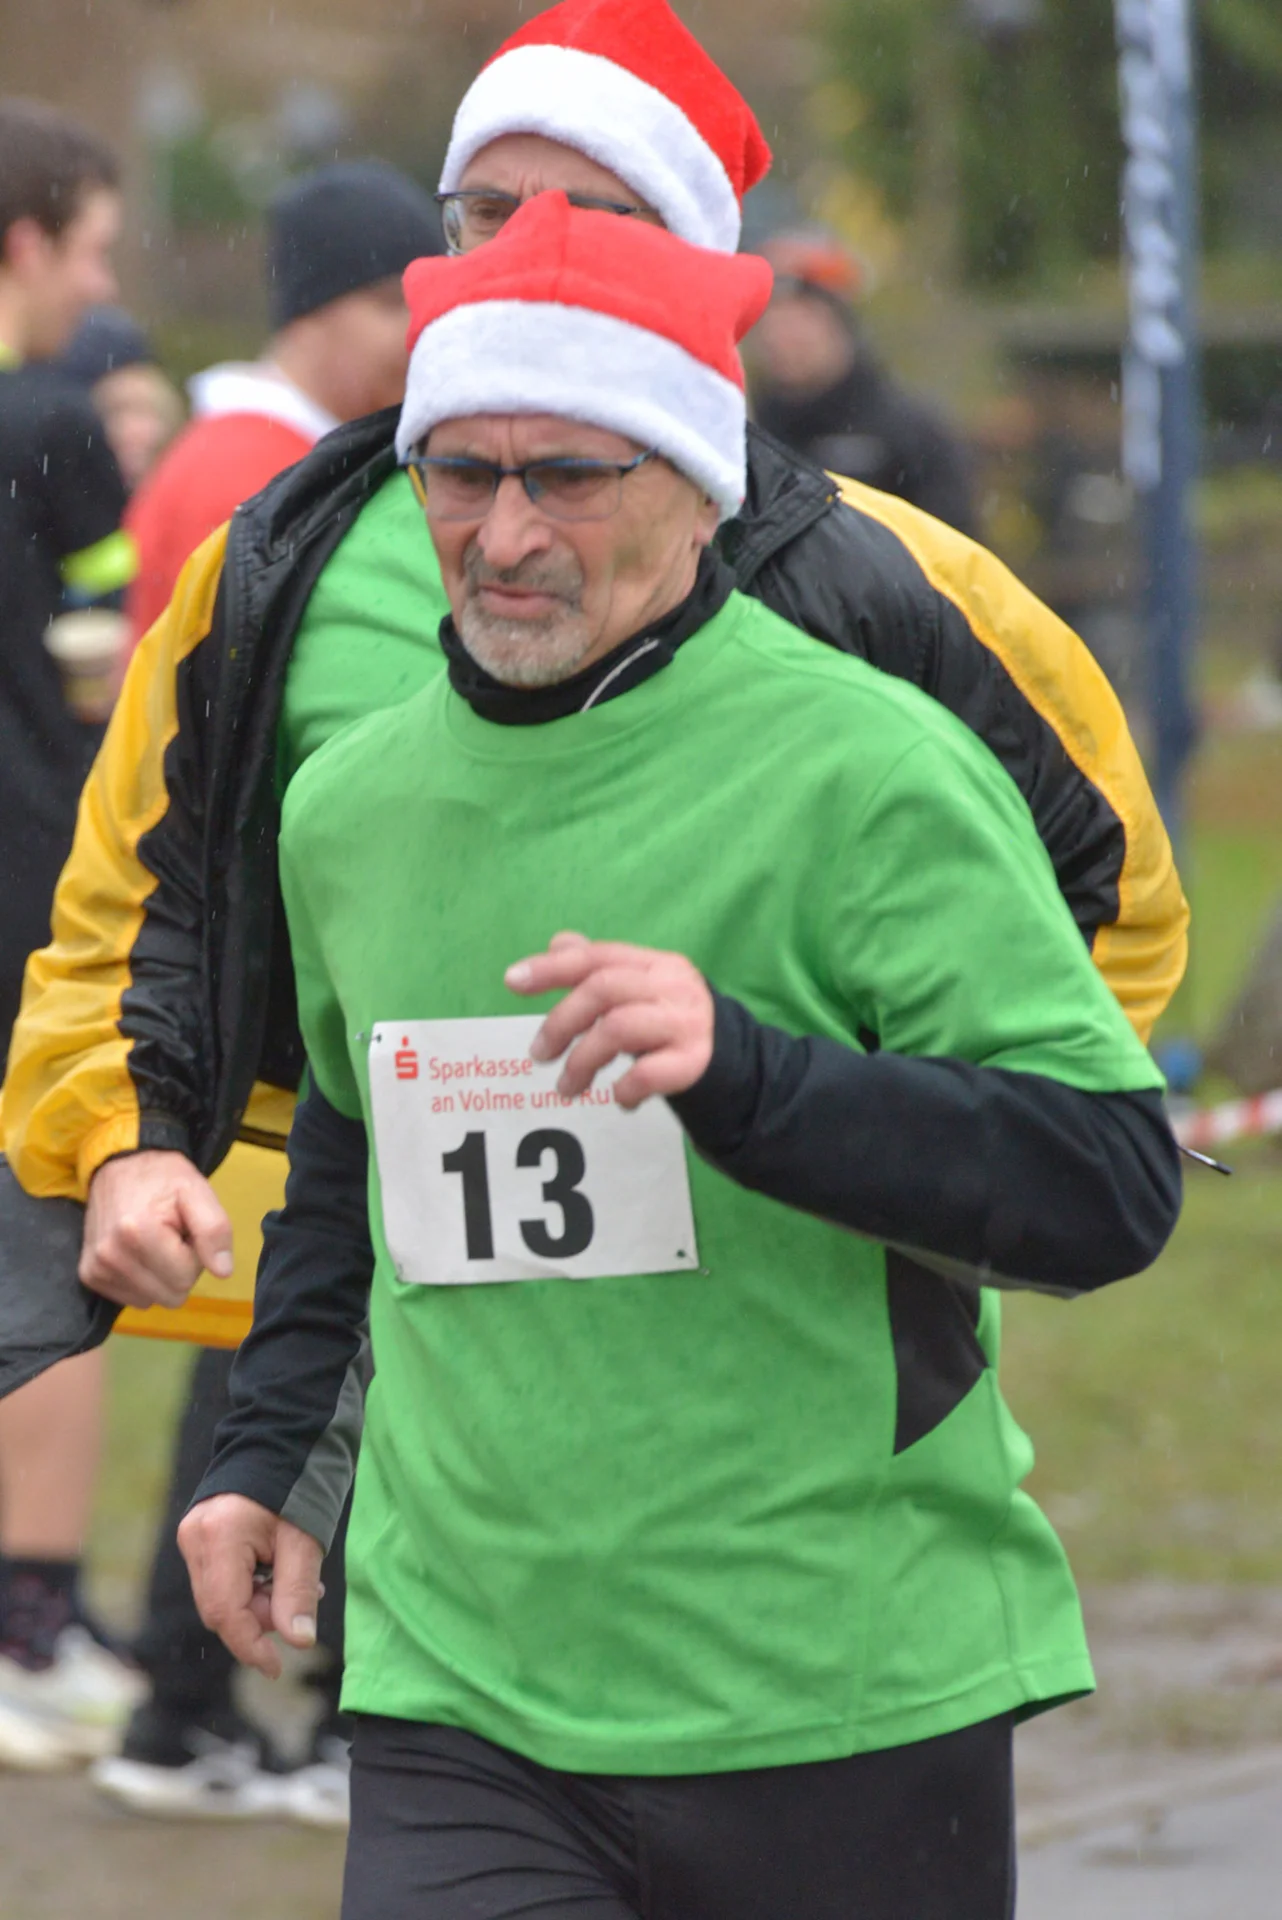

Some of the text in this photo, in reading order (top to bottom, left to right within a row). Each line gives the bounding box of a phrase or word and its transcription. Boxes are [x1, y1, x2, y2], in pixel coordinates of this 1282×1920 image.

[428, 1054, 533, 1085] Sparkasse
[431, 1096, 454, 1113] an
[458, 1088, 525, 1112] Volme
[442, 1127, 595, 1261] 13
